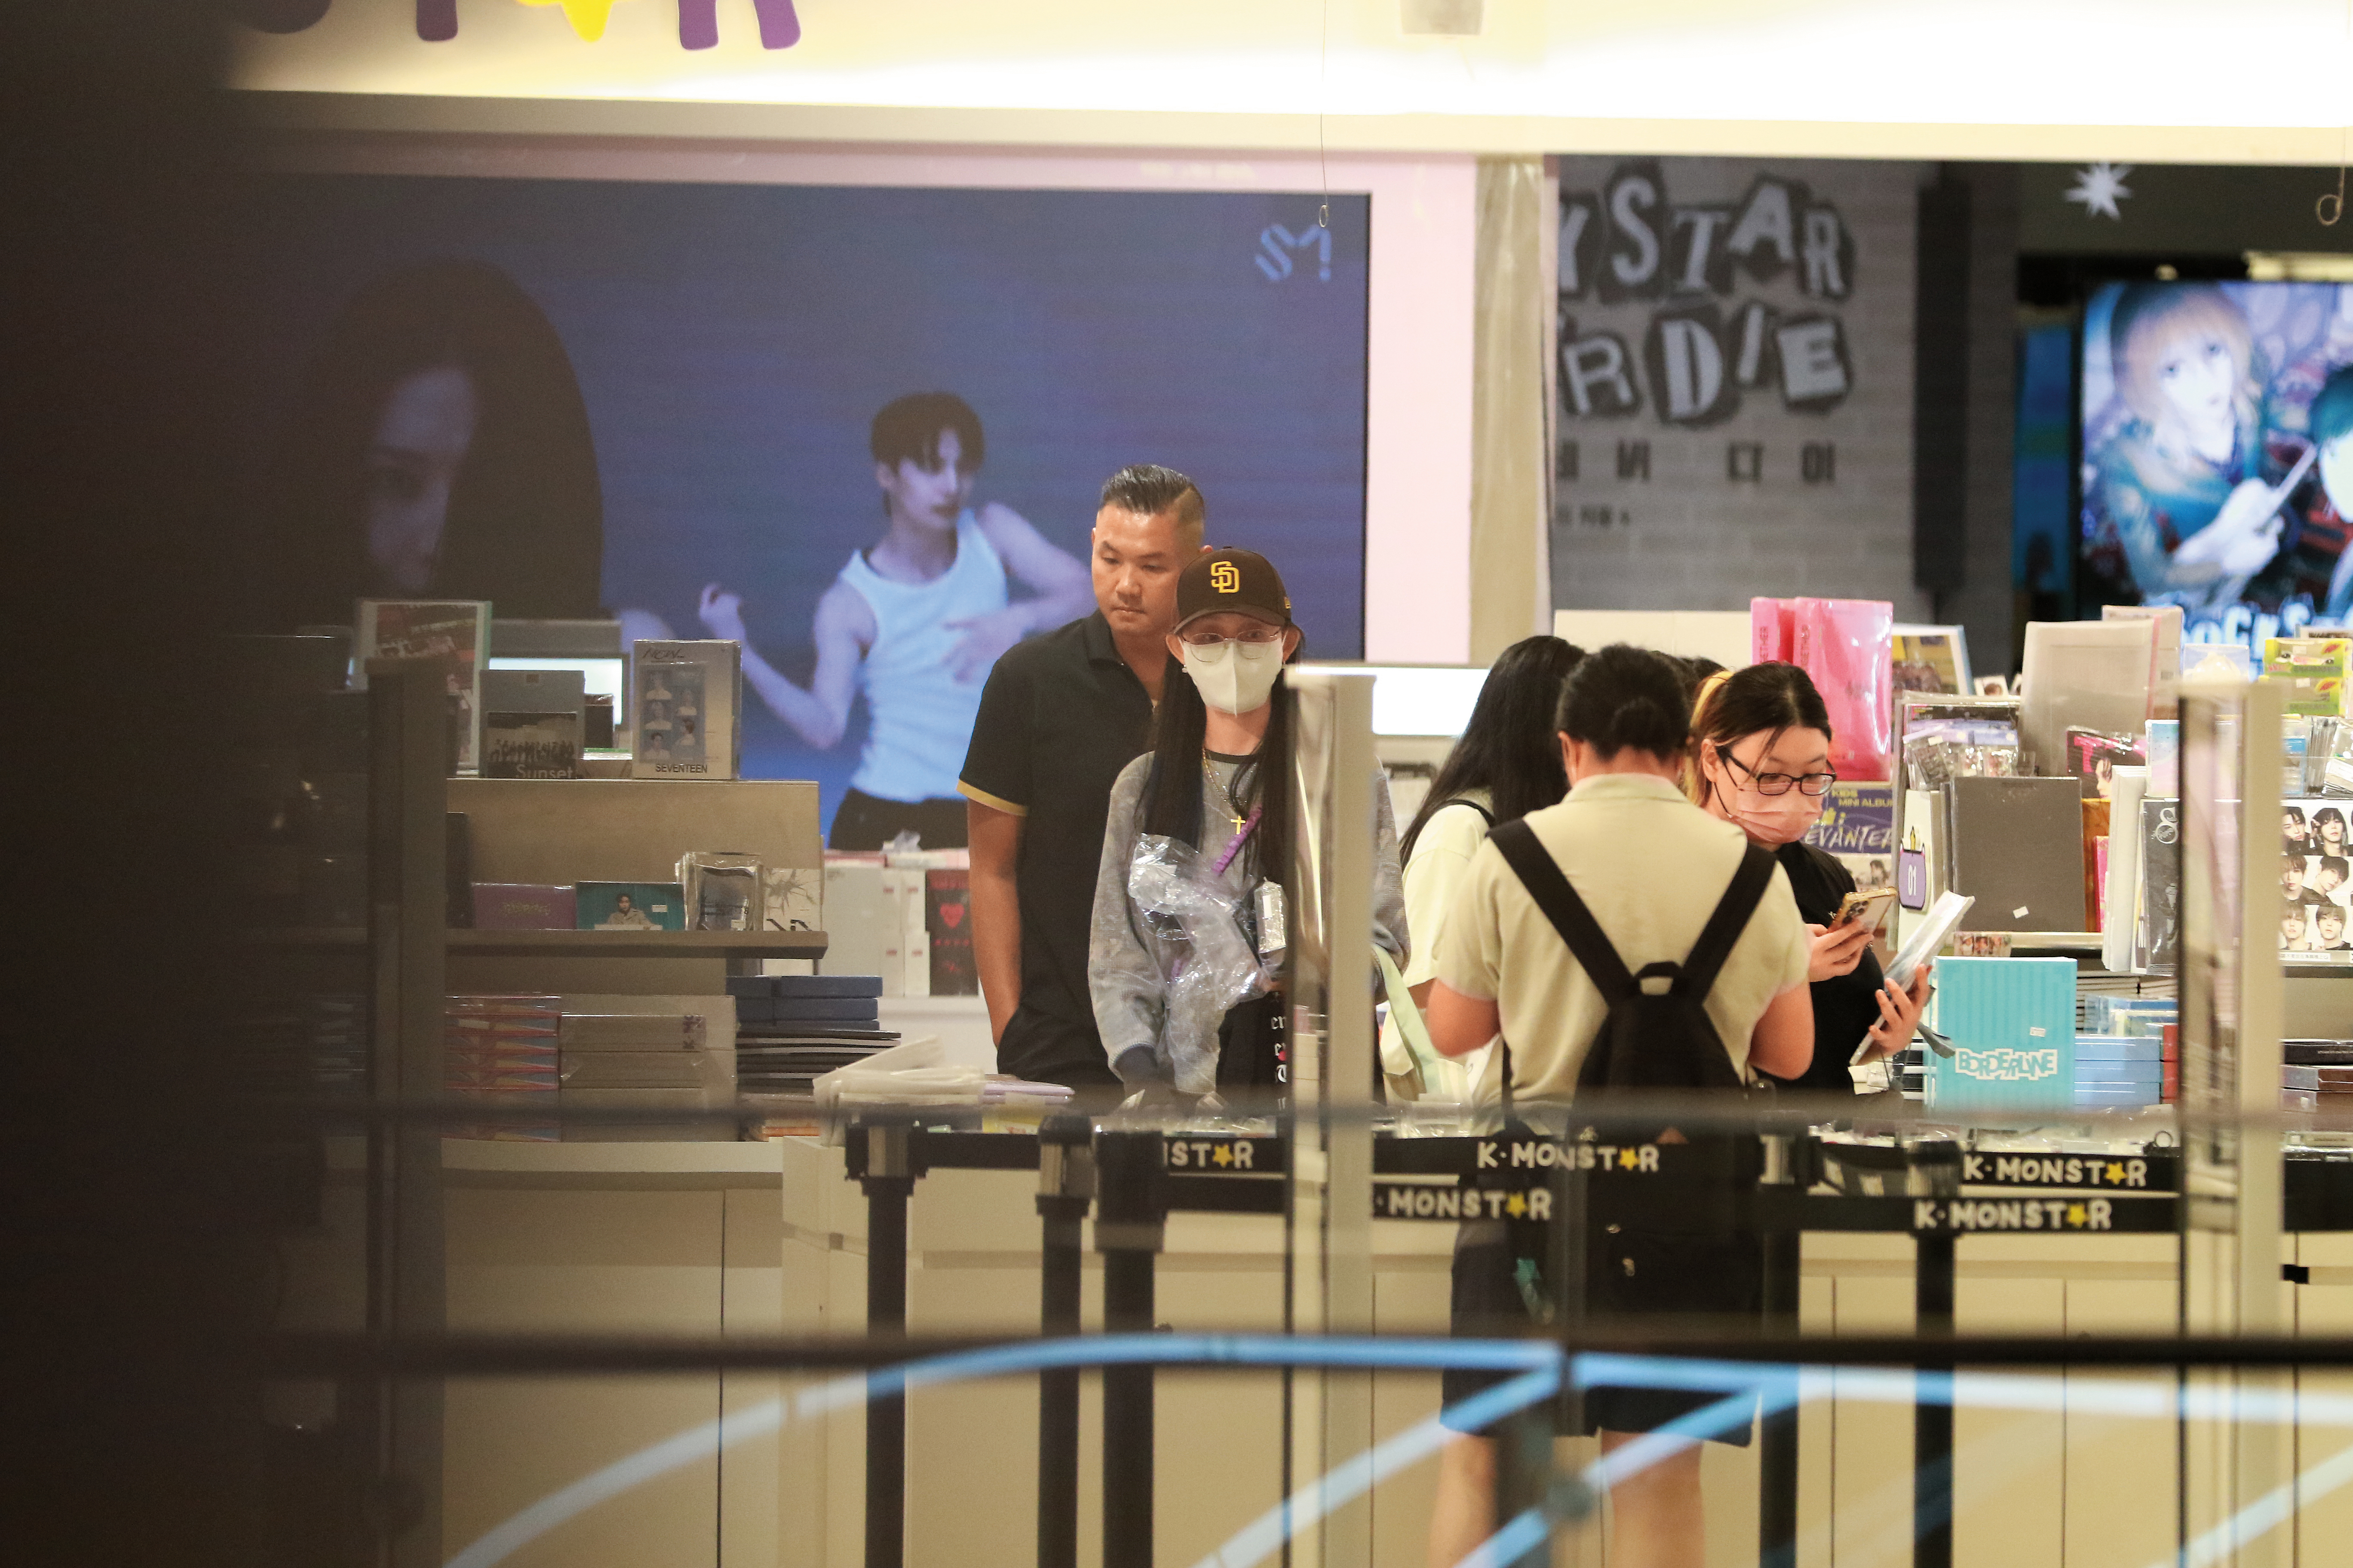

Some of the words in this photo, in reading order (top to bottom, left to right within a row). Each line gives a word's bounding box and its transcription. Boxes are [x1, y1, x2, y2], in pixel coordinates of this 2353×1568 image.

[1211, 561, 1239, 593] SD
[516, 763, 573, 778] Sunset
[656, 764, 707, 773] SEVENTEEN
[1908, 864, 1917, 896] 01
[1163, 1140, 1254, 1169] STR
